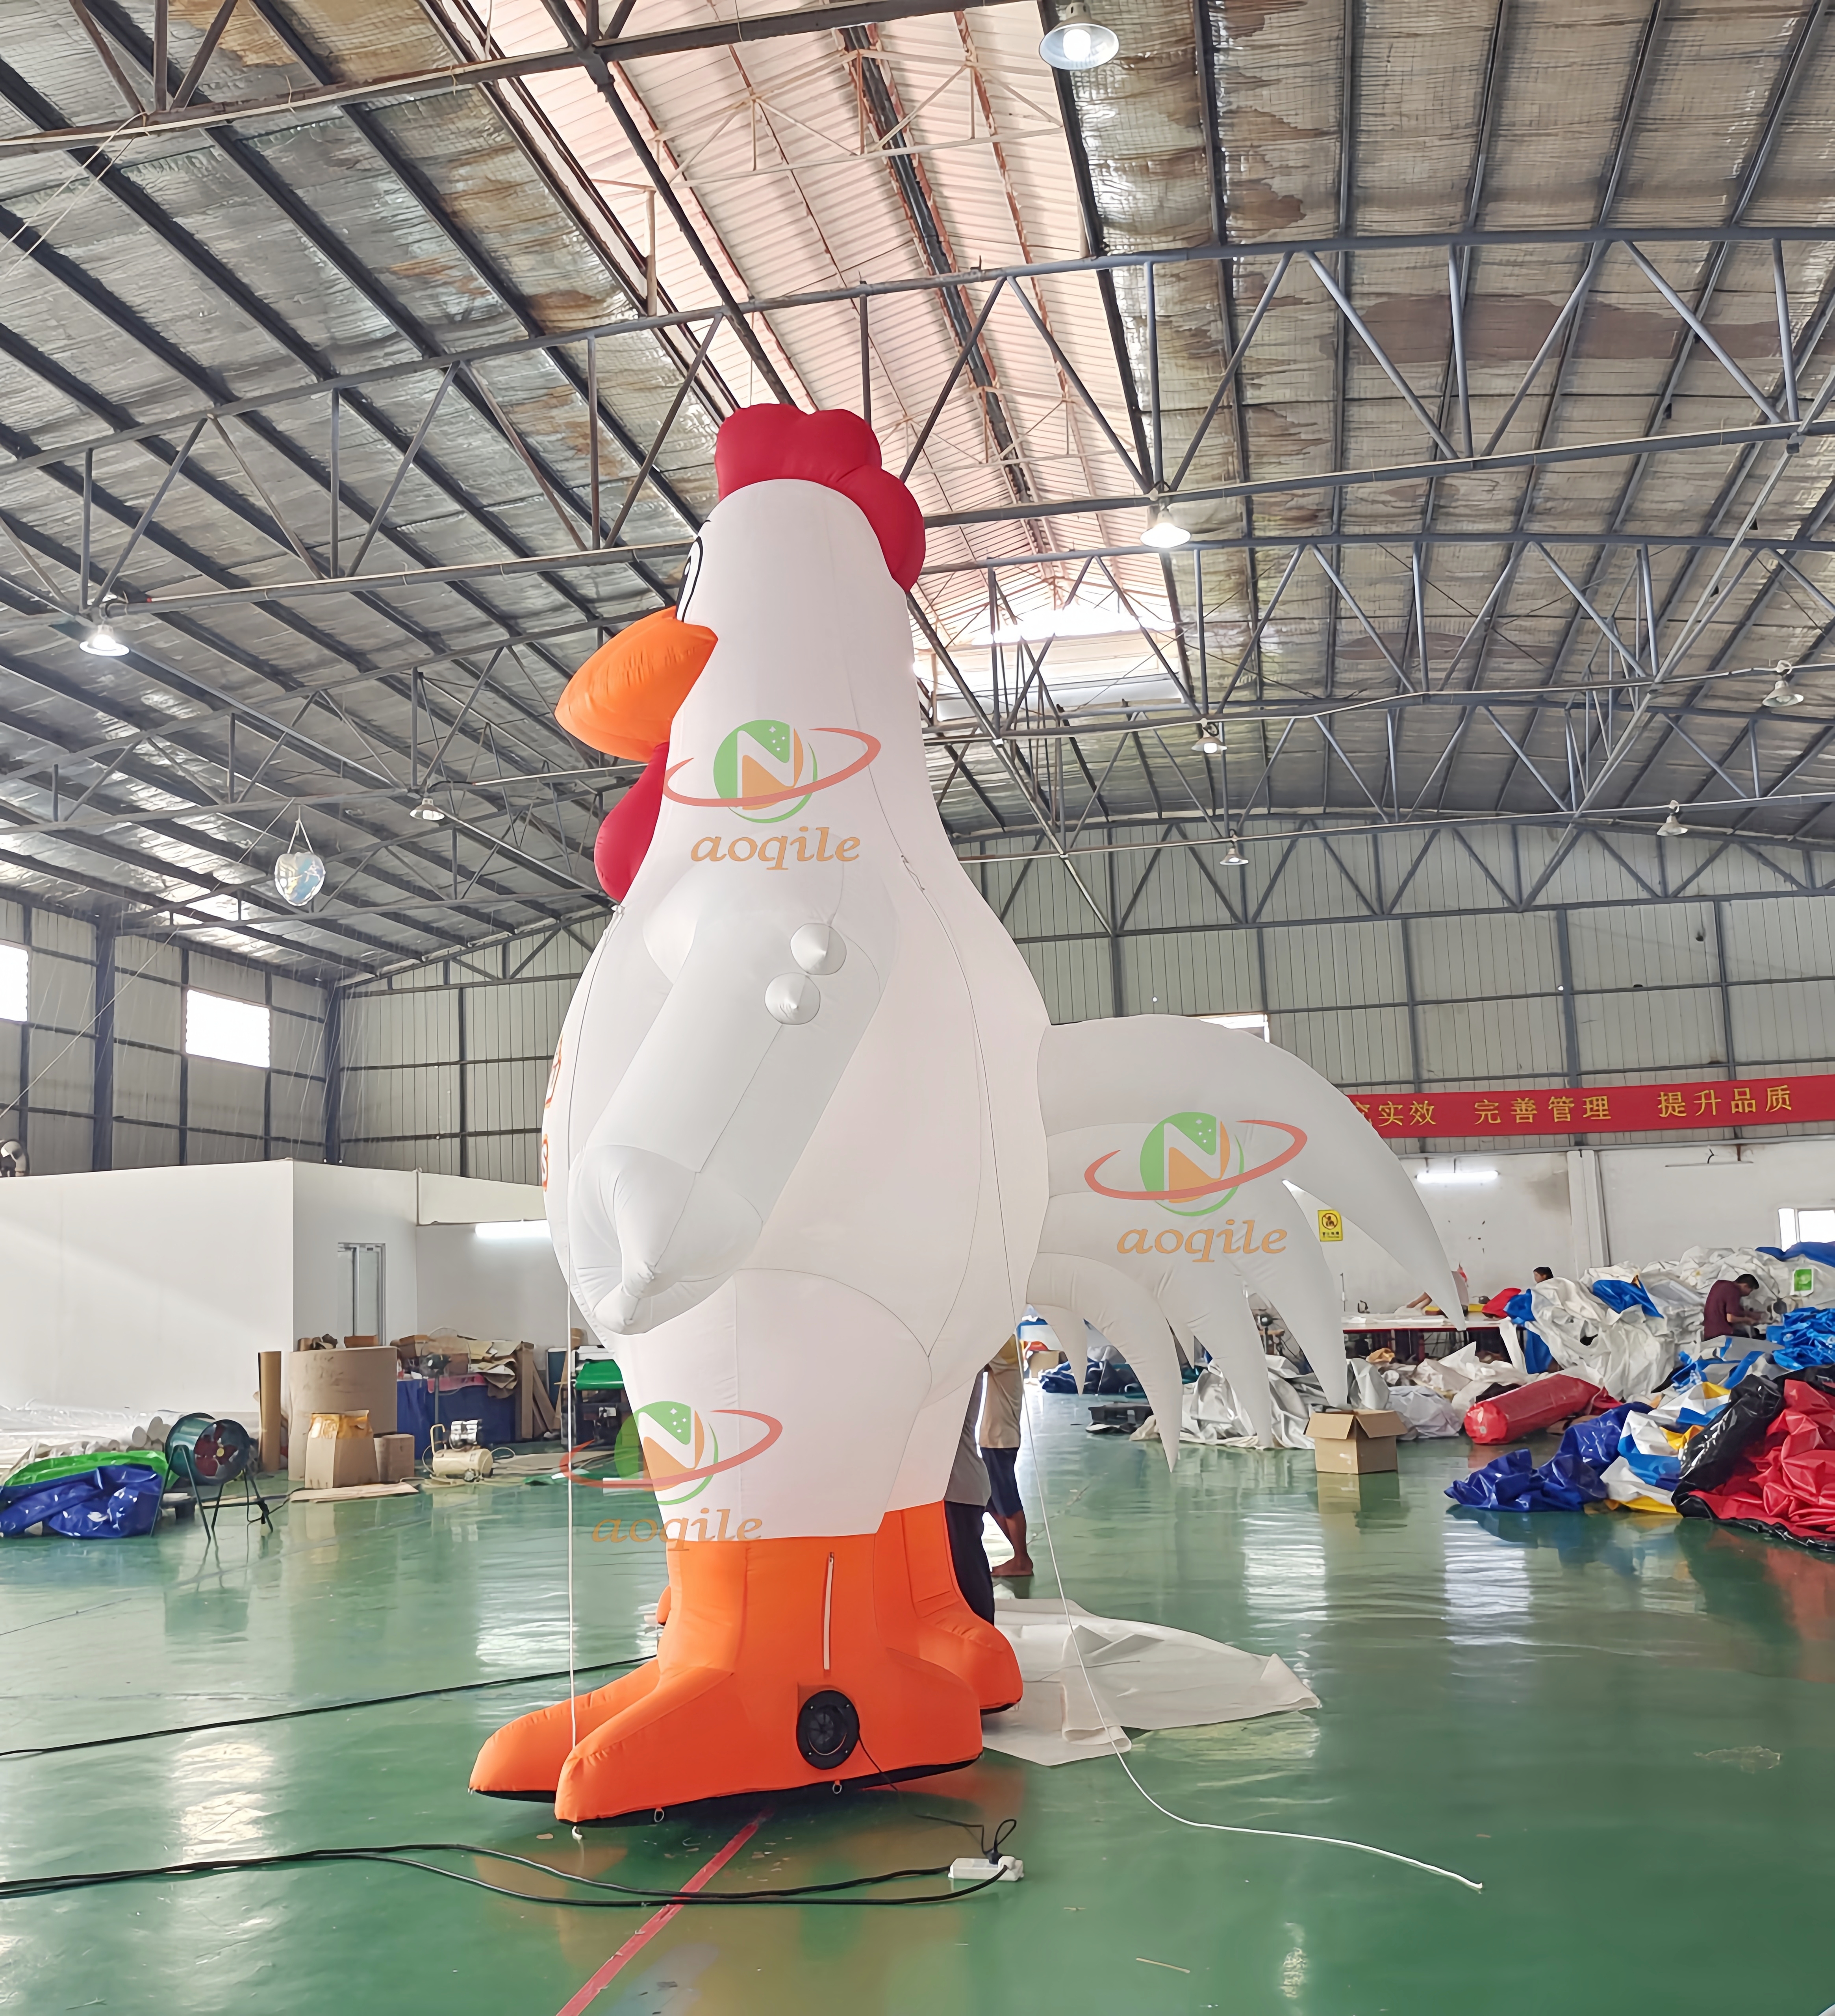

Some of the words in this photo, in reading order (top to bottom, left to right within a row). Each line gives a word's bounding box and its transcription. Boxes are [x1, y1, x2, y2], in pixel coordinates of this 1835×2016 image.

[1474, 1096, 1611, 1125] 完善管理
[1657, 1085, 1792, 1117] 提升品质
